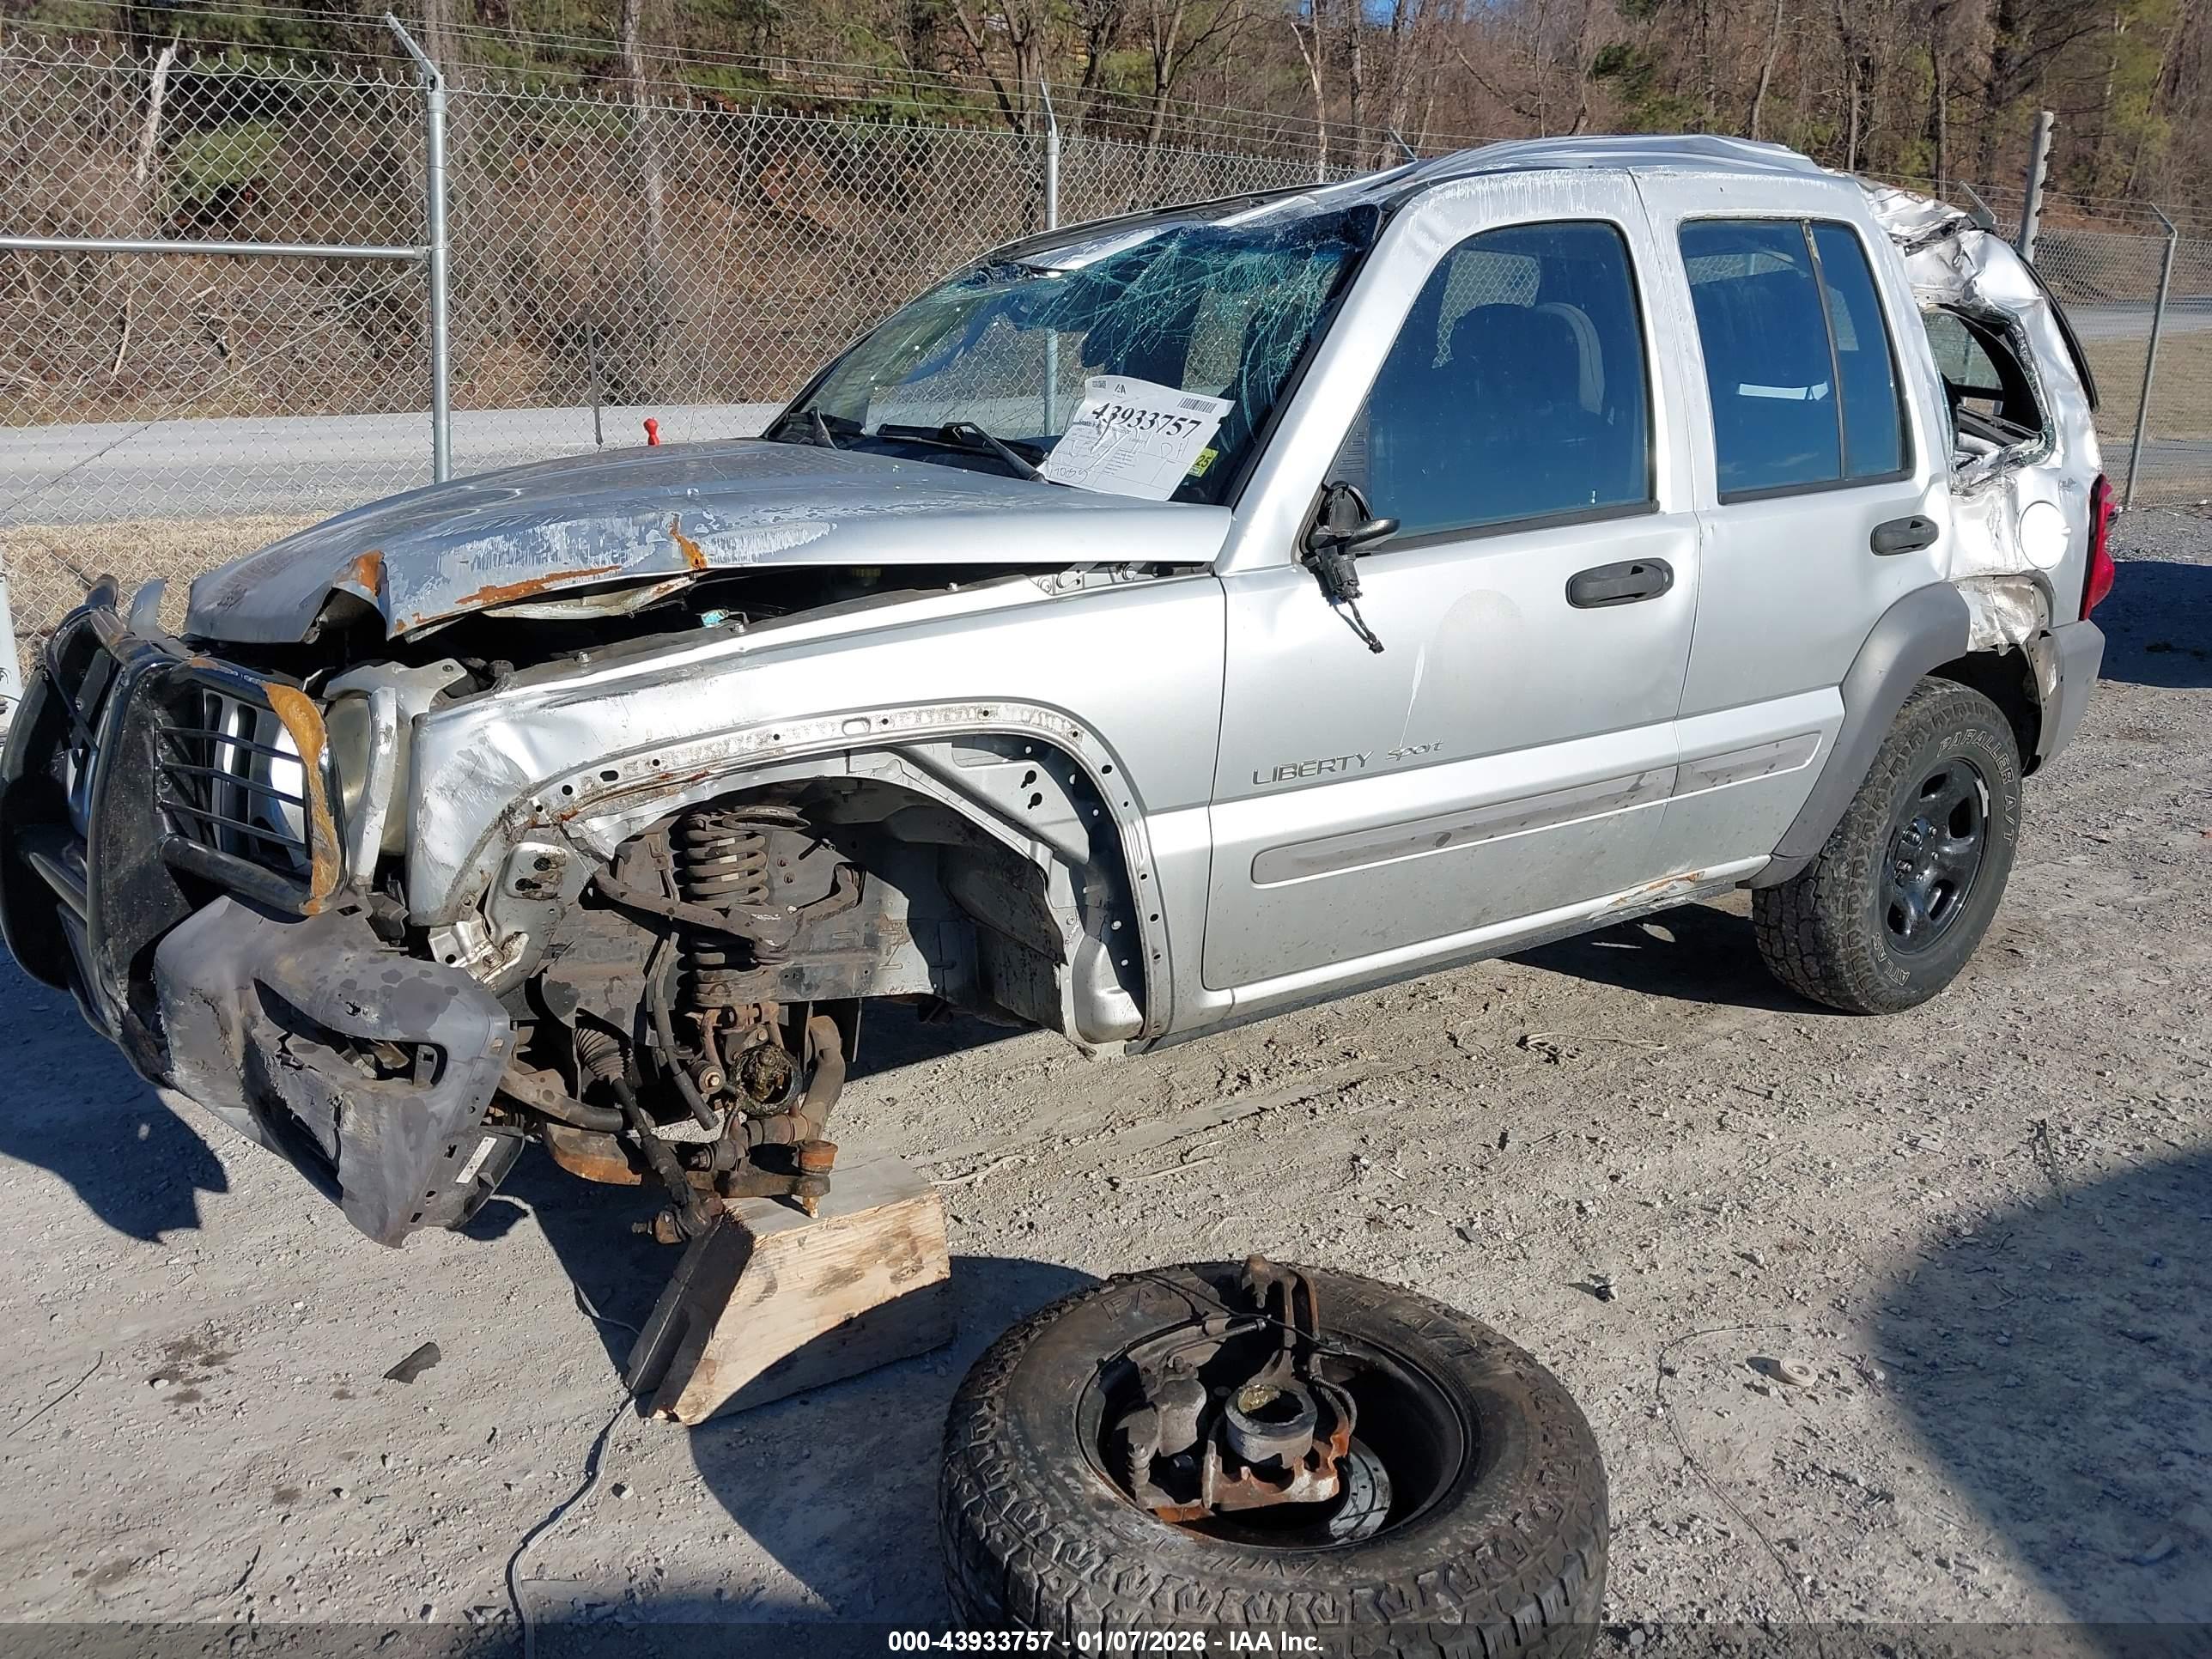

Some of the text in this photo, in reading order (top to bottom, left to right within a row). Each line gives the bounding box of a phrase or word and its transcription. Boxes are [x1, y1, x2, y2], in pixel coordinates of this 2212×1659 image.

[1092, 402, 1201, 439] 43933757
[1194, 454, 1212, 468] 25
[1252, 750, 1373, 785] LIBERTY
[1937, 729, 2017, 847] PARALLER A/T
[1872, 932, 1911, 987] ATLAS
